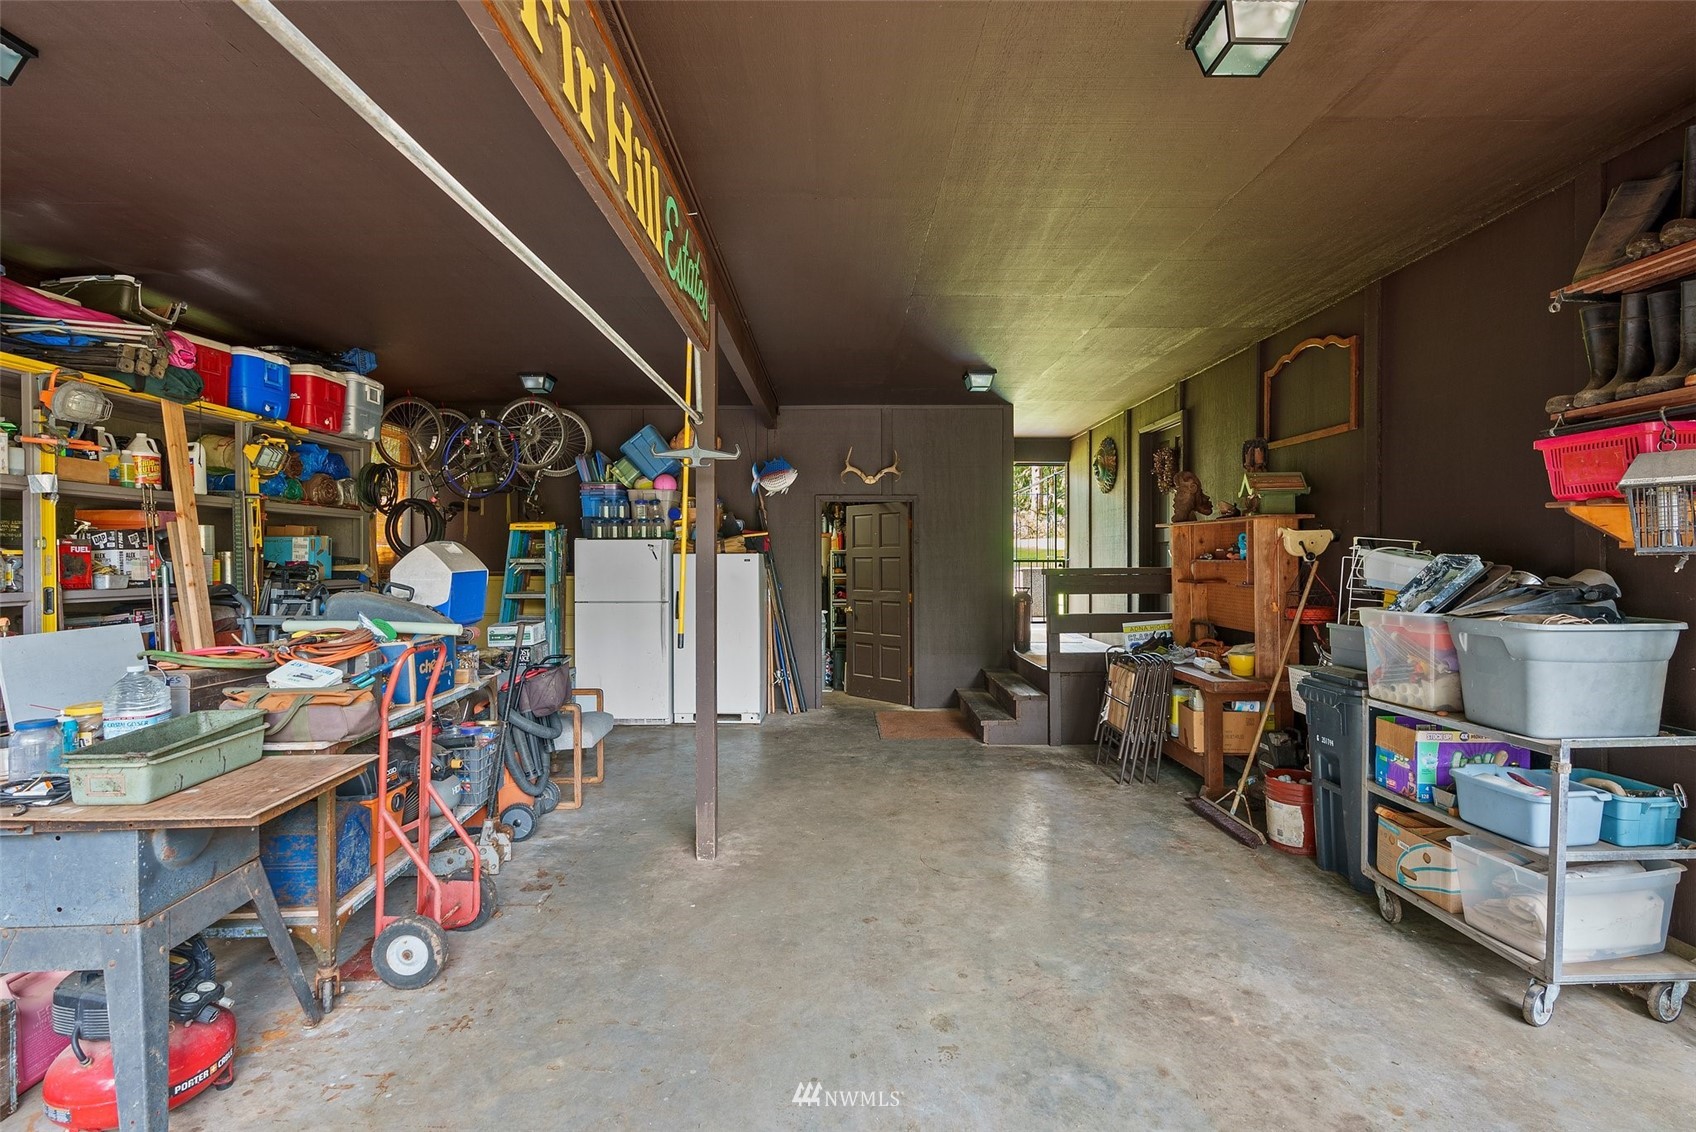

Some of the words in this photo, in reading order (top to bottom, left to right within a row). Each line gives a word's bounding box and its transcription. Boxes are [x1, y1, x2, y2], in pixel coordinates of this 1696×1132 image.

[603, 63, 663, 258] Hill
[664, 195, 708, 321] Estates
[94, 534, 106, 544] DAP
[174, 1069, 209, 1095] PORTER
